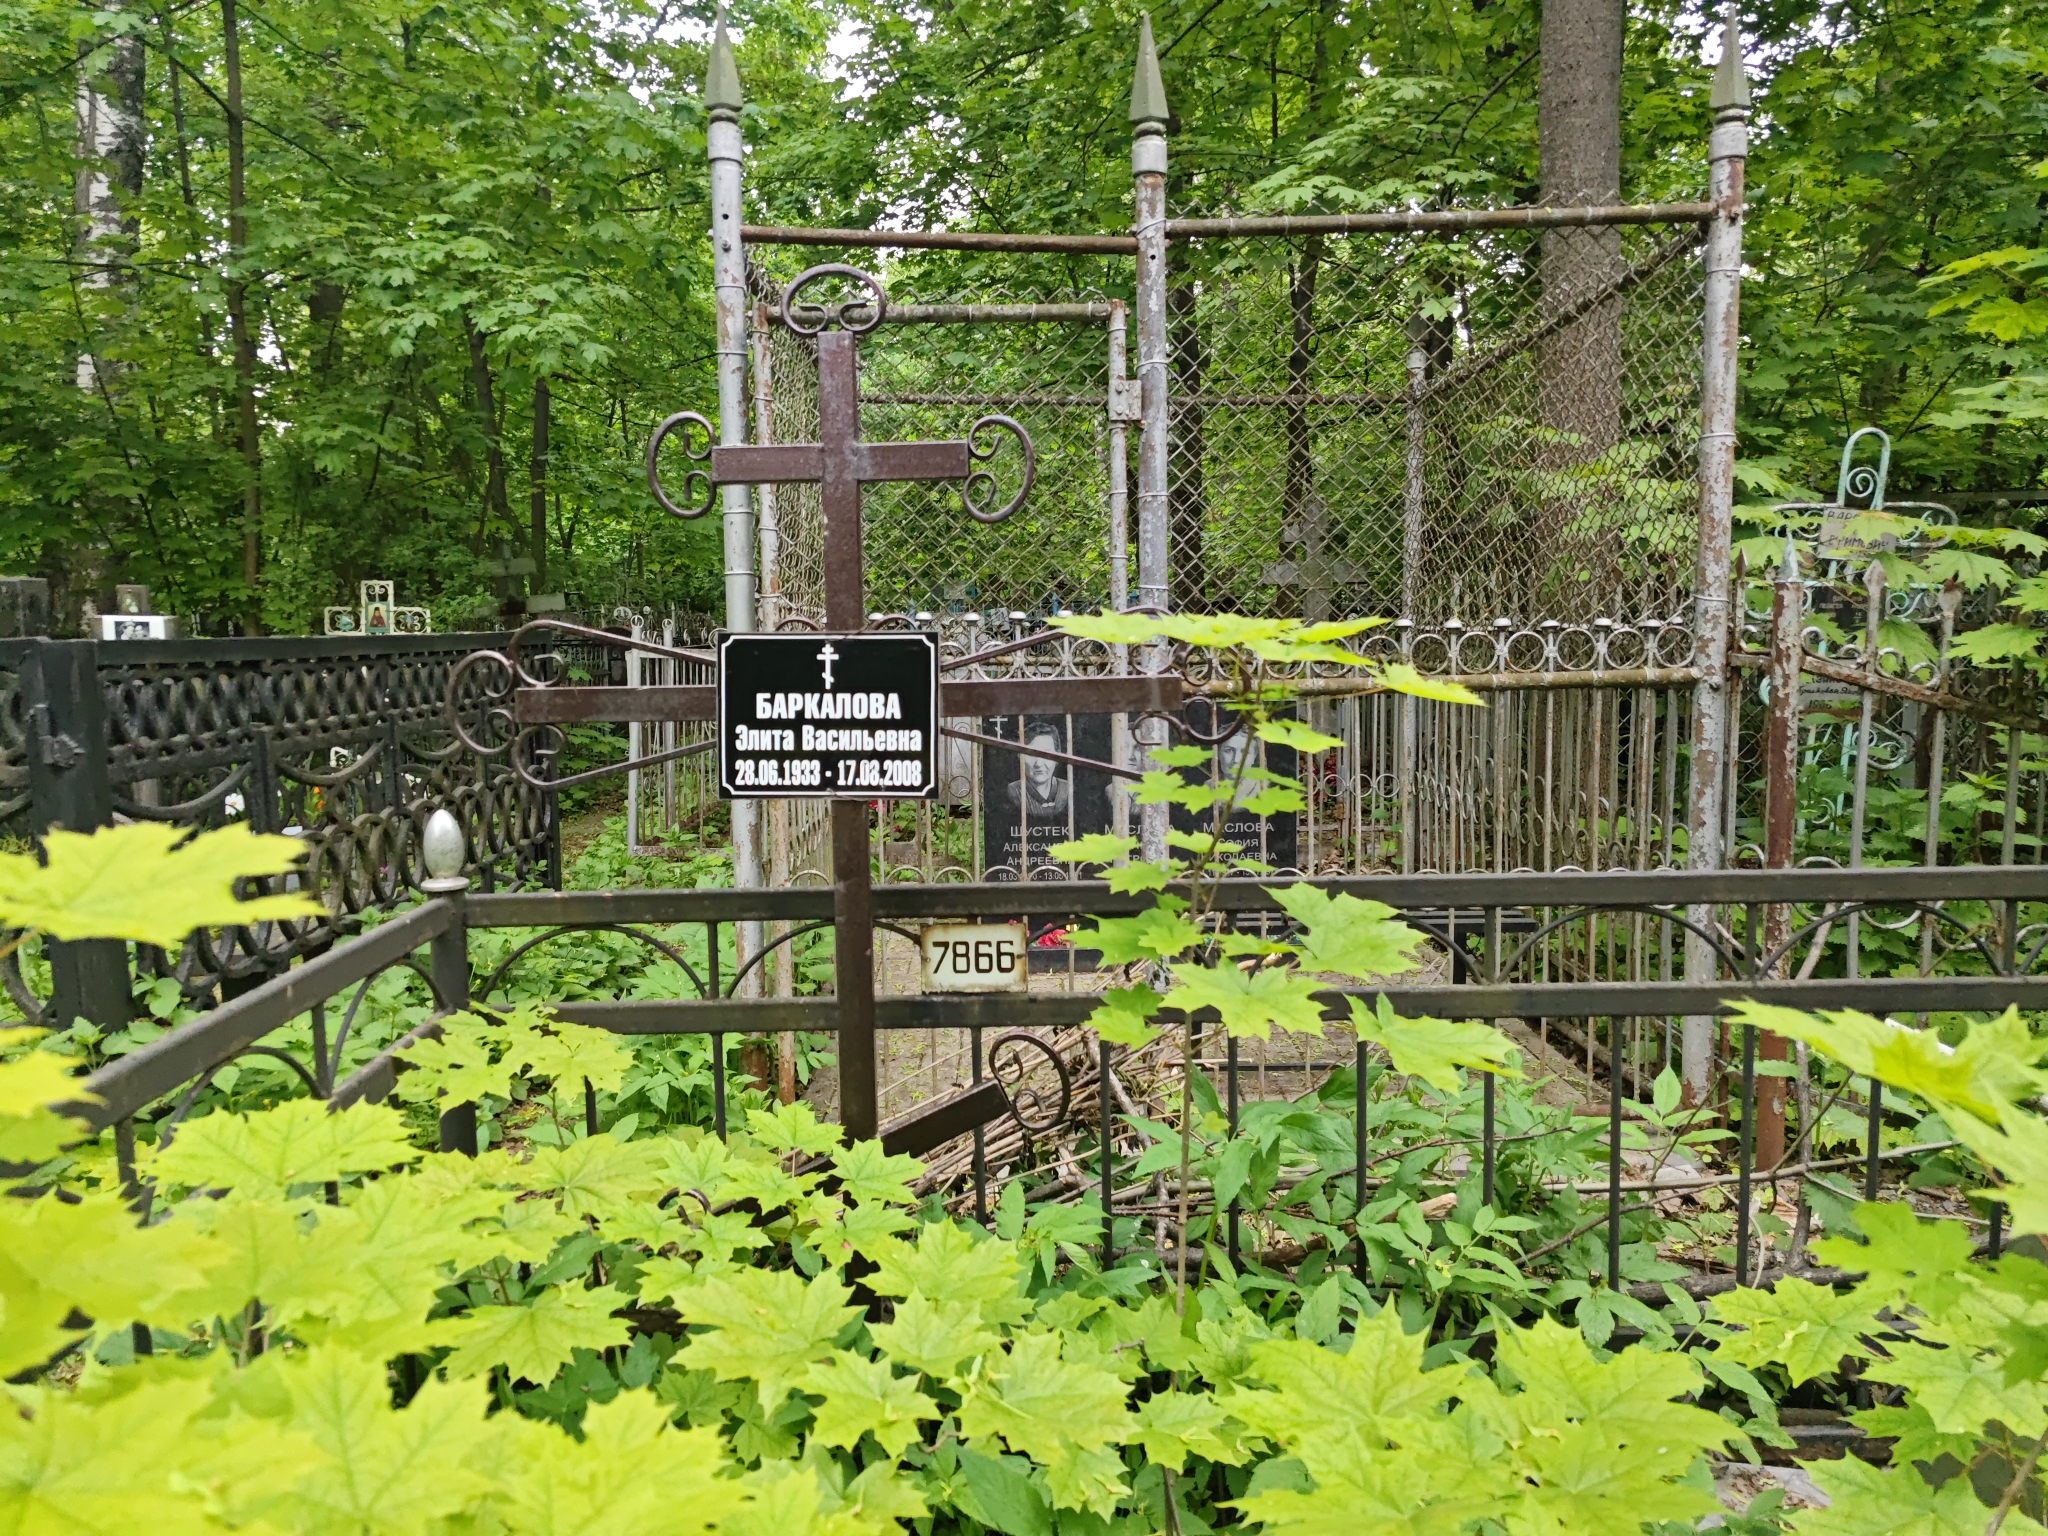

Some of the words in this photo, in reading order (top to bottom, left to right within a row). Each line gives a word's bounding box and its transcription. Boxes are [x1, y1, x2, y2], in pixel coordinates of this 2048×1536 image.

[756, 692, 901, 719] БАРКАЛОВА
[735, 724, 795, 751] Элита
[801, 724, 922, 751] Васильевна
[735, 759, 821, 786] 28.06.1933
[837, 759, 922, 787] 17.08.2008
[1203, 822, 1274, 833] МСЛОВА
[932, 940, 1015, 974] 7866
